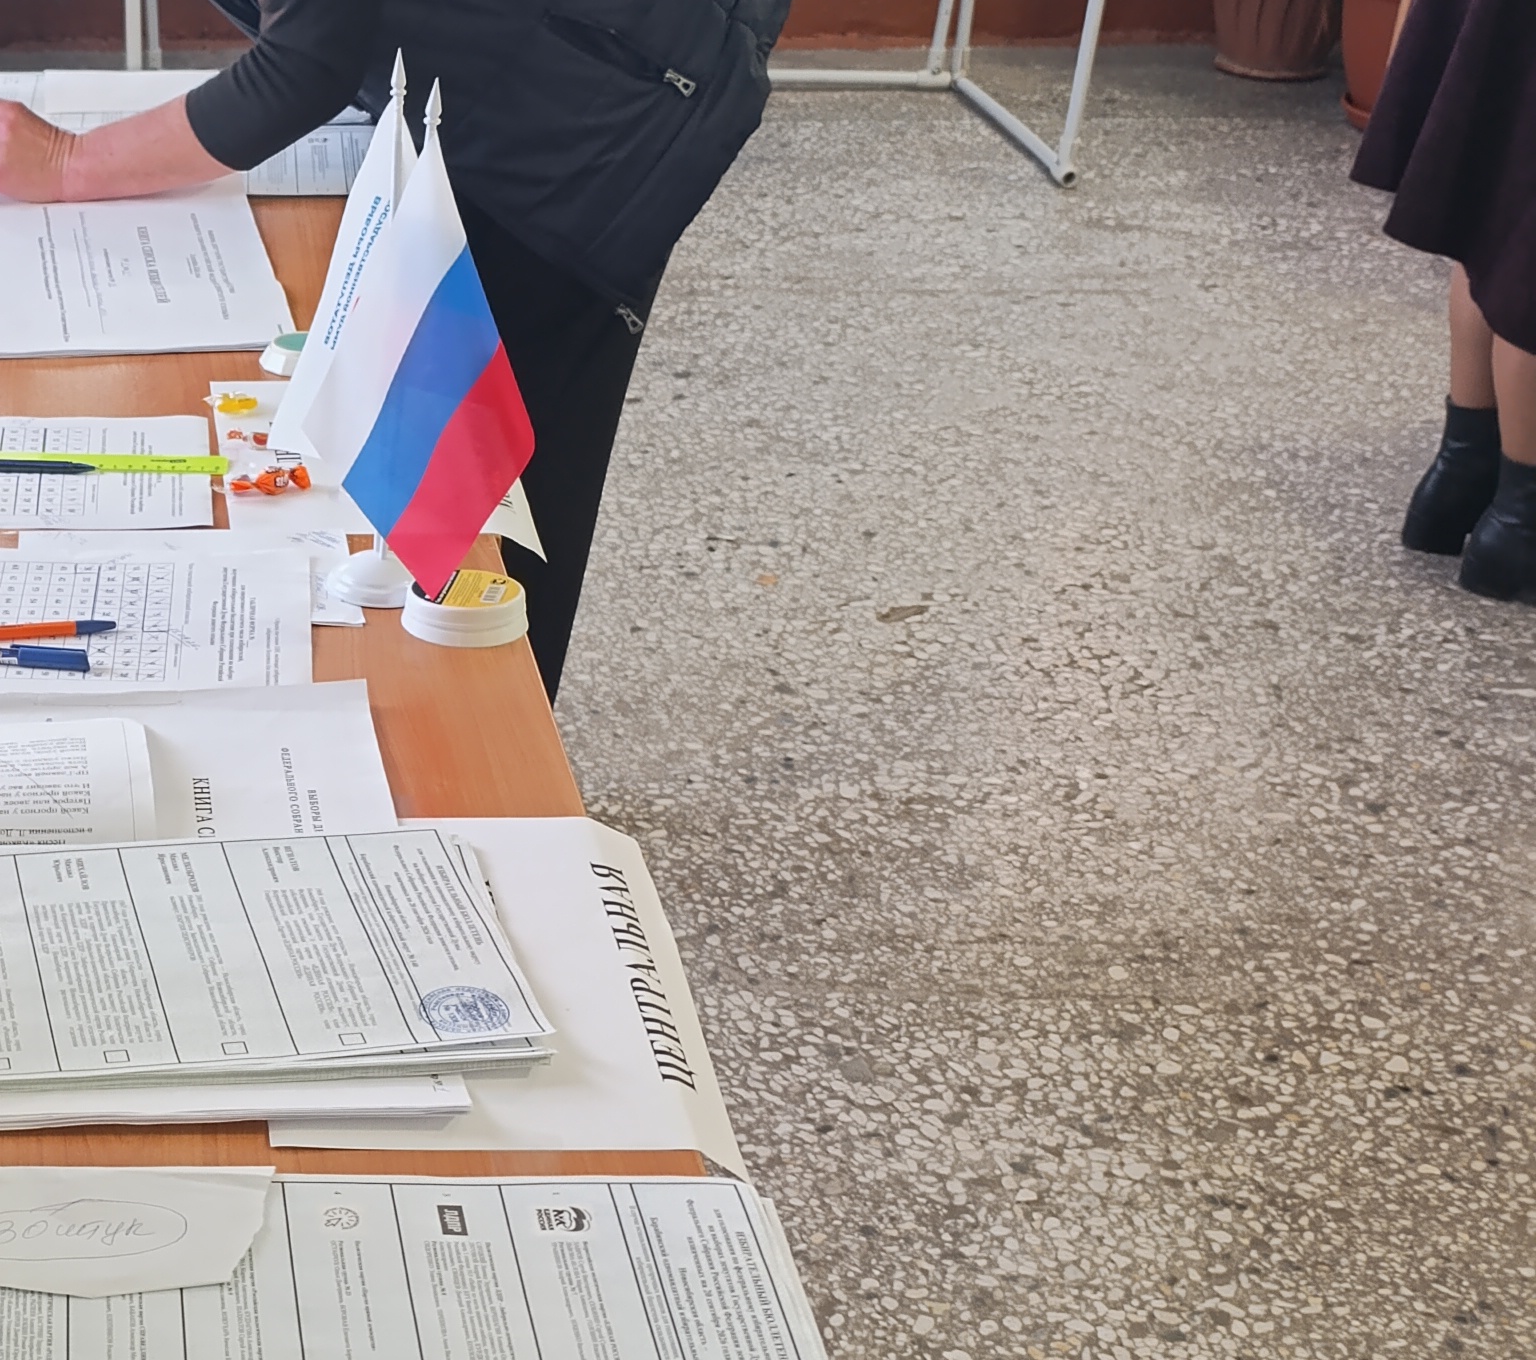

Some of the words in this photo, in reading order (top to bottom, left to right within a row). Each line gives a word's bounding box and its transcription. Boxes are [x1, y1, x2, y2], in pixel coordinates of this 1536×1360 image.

[191, 777, 213, 823] КНИГА
[280, 747, 298, 802] ФЕДЕРАЛЬНОГО
[289, 803, 303, 834] СОБРАН
[306, 789, 322, 822] ВЫБОРЫ
[590, 861, 698, 1094] ЦЕНТРАЛЬНАЯ
[440, 1208, 463, 1233] ЛДПР
[533, 1208, 547, 1231] РОССИЯ
[733, 1230, 773, 1306] ИЗБИРАТЕЛЬНЫЙ
